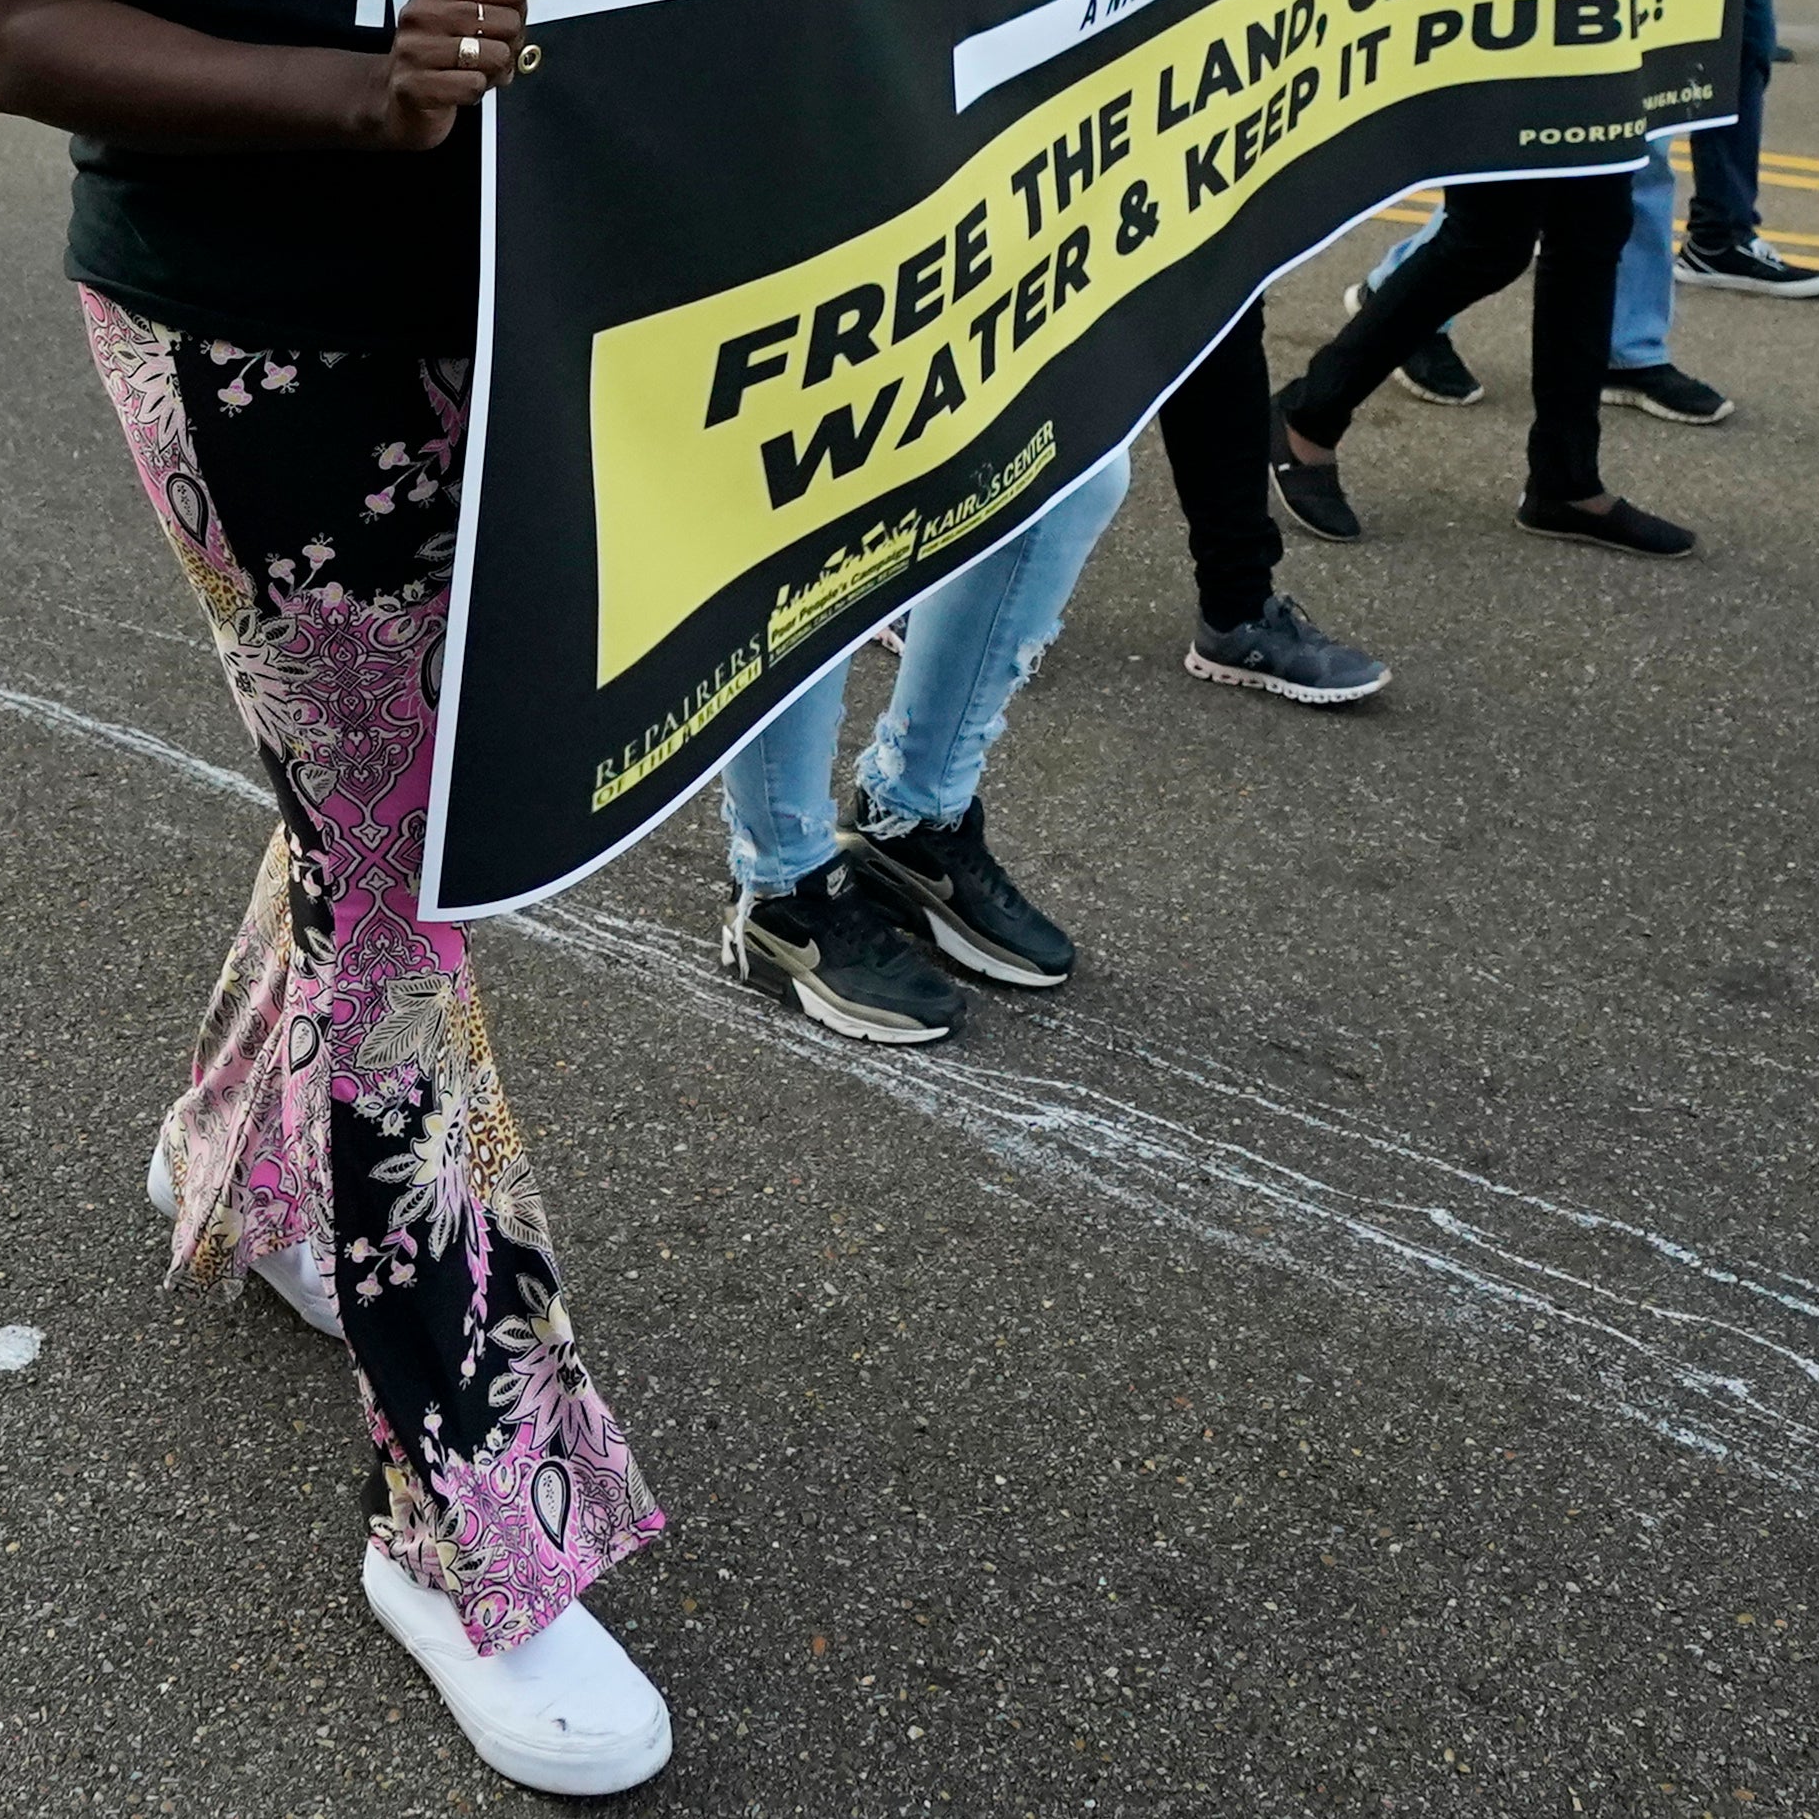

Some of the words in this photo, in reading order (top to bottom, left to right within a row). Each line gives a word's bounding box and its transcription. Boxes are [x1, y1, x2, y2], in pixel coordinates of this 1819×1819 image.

[1519, 117, 1648, 147] POORPEO
[703, 202, 991, 430] FREE
[1011, 89, 1138, 237] THE
[758, 225, 1092, 513] WATER
[1114, 173, 1161, 258] &
[1183, 70, 1321, 214] KEEP
[1338, 25, 1392, 101] IT
[1001, 419, 1055, 487] CENTER
[770, 617, 798, 645] Poor
[798, 583, 848, 626] People's
[849, 541, 912, 587] Campaign
[595, 632, 762, 789] REPAIRERS
[595, 779, 626, 808] OF
[637, 738, 676, 780] THE
[694, 661, 761, 728] BREACH
